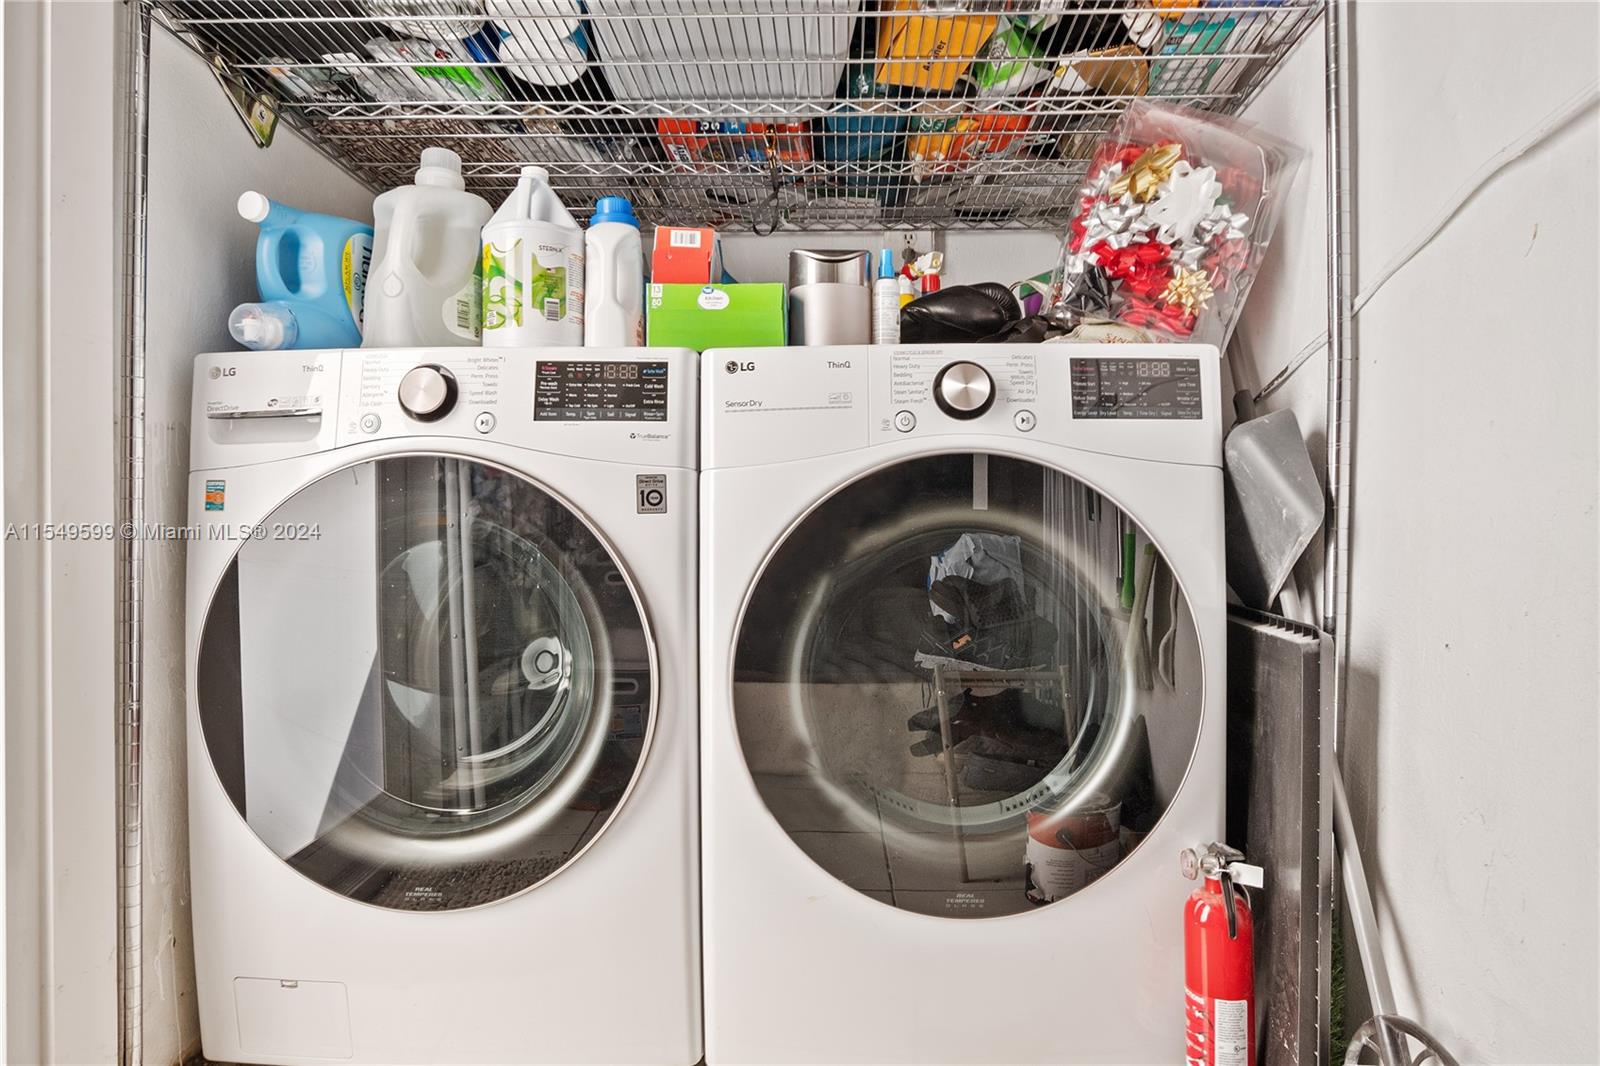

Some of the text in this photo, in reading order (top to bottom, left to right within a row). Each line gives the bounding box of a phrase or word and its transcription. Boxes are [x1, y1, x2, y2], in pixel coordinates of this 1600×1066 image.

[302, 364, 324, 372] ThinQ
[740, 361, 756, 371] LG
[827, 361, 852, 369] ThinQ
[222, 367, 237, 377] LG
[640, 489, 663, 507] 10
